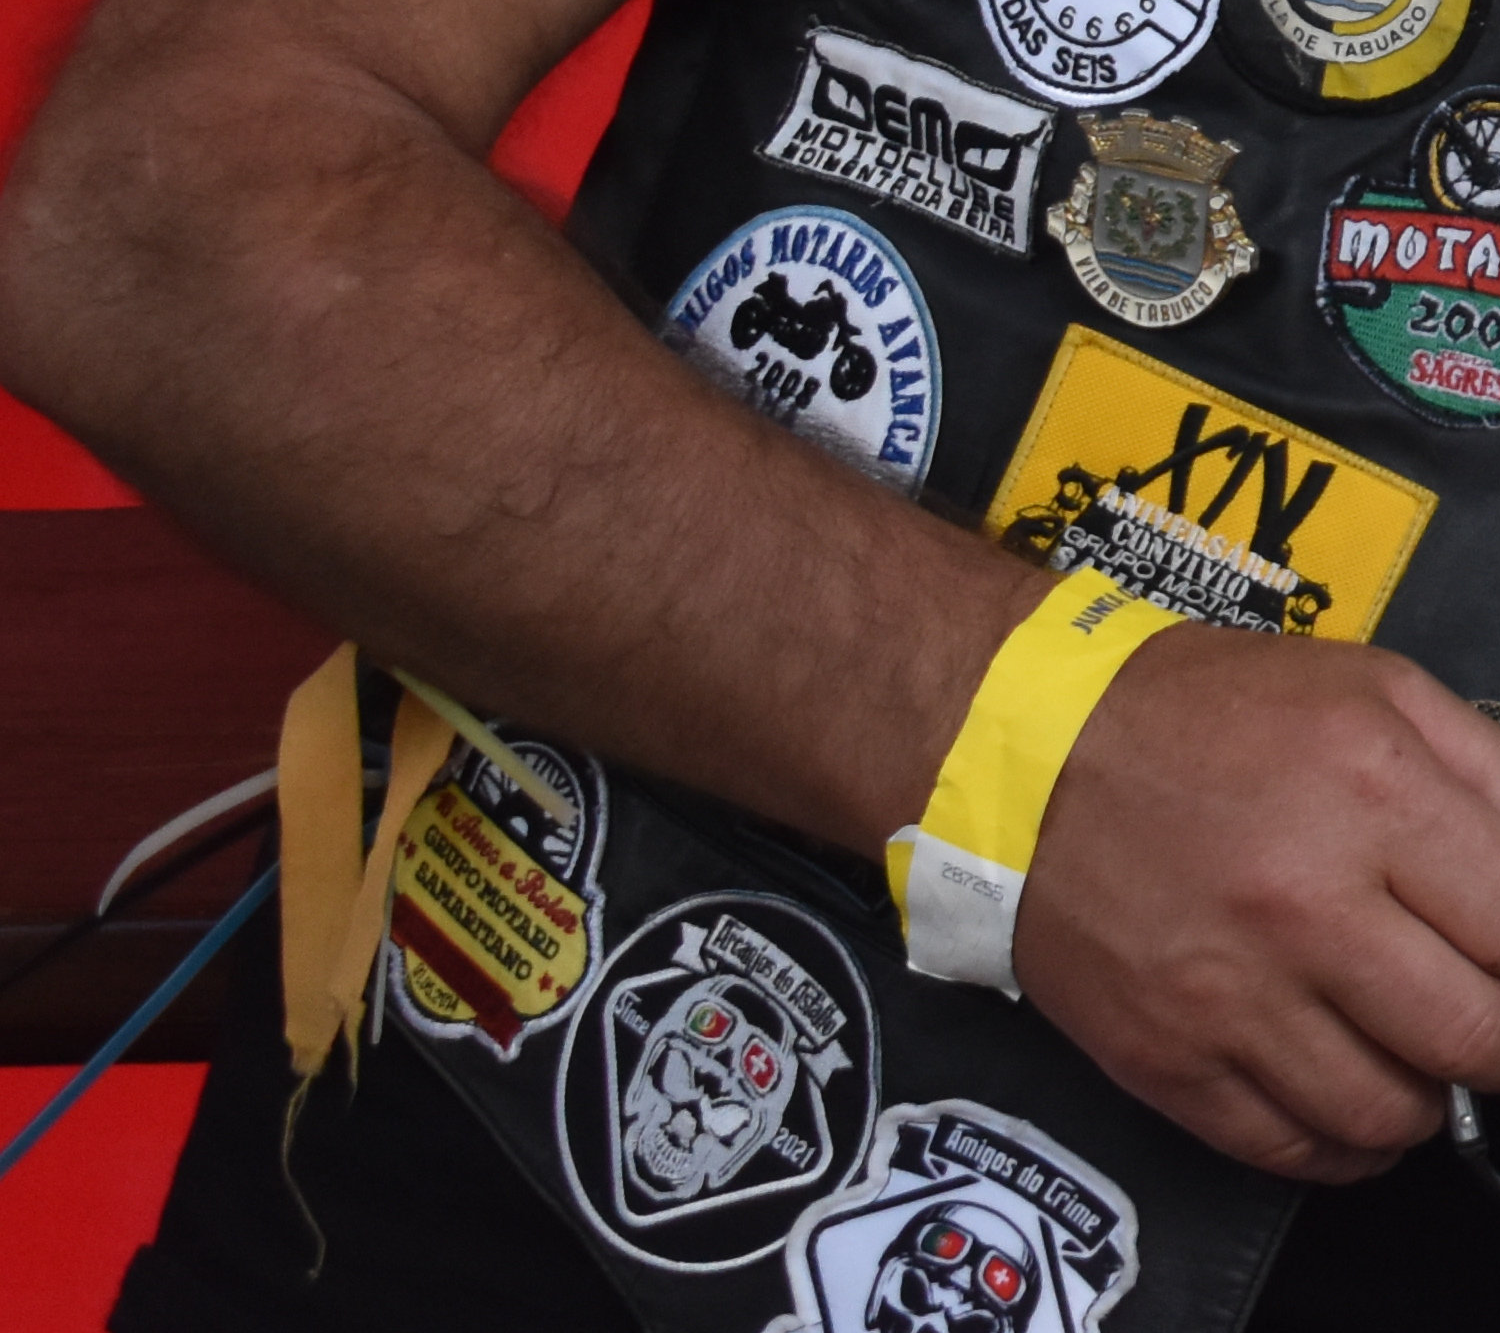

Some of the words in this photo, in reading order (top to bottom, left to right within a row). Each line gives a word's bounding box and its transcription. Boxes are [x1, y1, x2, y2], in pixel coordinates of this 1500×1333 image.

[1058, 5, 1077, 30] 6
[1085, 16, 1104, 41] 6
[1114, 12, 1135, 35] 6
[1292, 26, 1320, 52] DE
[1333, 4, 1428, 58] TABUAÇO
[1051, 46, 1119, 85] SEIS
[811, 62, 1027, 193] DEMO
[780, 141, 906, 199] MOIMENTA
[910, 183, 945, 211] DA
[947, 197, 1018, 247] BEIRA
[792, 117, 1017, 225] MOTOCLUBE
[674, 237, 757, 332] MIGOS
[765, 221, 899, 309] MOTARDS
[1075, 255, 1111, 296] VILA
[1107, 293, 1131, 316] DE
[1134, 280, 1214, 323] TABUAÇO
[1062, 525, 1157, 580] GRUPO
[1111, 520, 1252, 602] CONVIVIO
[414, 860, 534, 981] SAMARITANO
[423, 824, 485, 890] GRUPO
[477, 876, 561, 961] MOTARD
[712, 923, 777, 979] Arcanjos
[773, 963, 795, 994] do
[613, 989, 651, 1037] Since
[770, 1126, 817, 1169] 2021
[944, 1122, 1017, 1176] Amigos
[1017, 1162, 1042, 1194] do
[1042, 1176, 1102, 1233] Crime
